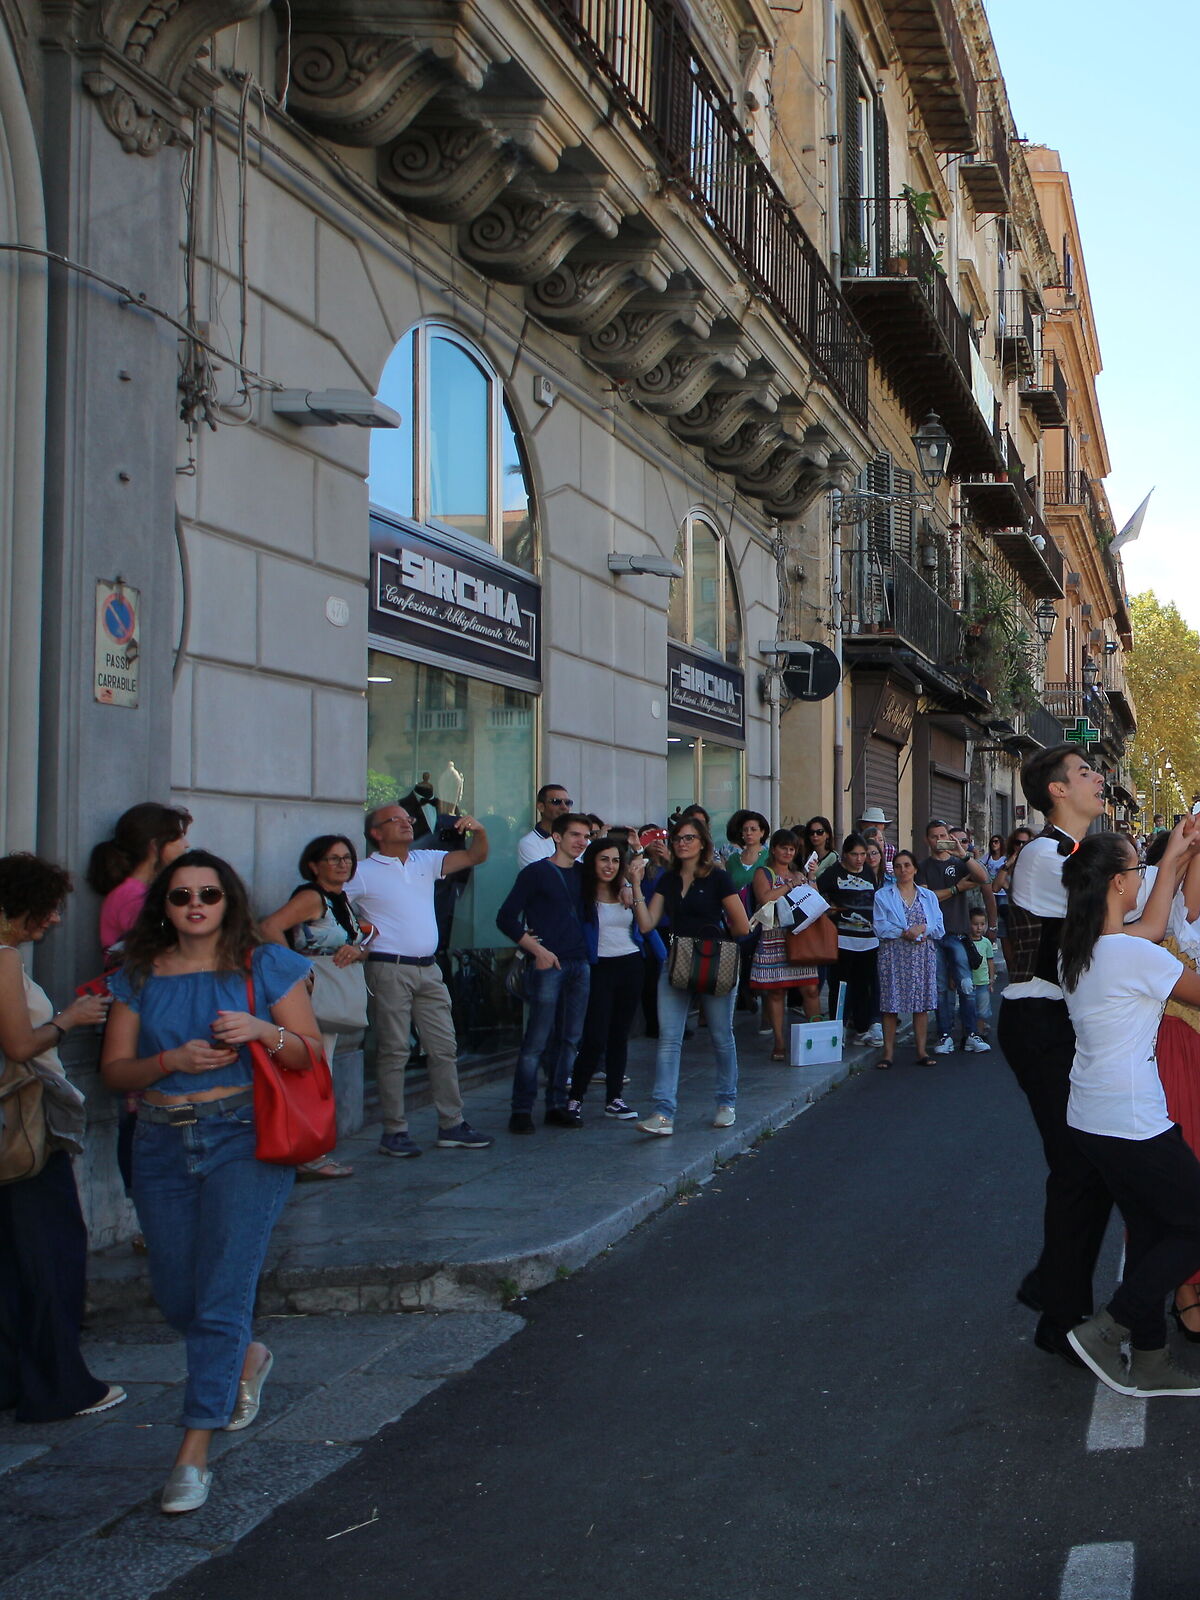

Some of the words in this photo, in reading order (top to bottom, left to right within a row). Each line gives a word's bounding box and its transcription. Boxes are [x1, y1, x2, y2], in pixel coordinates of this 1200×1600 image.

[401, 547, 522, 628] SIRCHIA
[385, 583, 438, 617] Confezioni
[439, 605, 503, 640] Abbigliamento
[505, 627, 530, 649] Uomo
[97, 673, 137, 692] CARRABILE
[106, 653, 130, 671] PASSO
[680, 662, 736, 706] SIRCHIA
